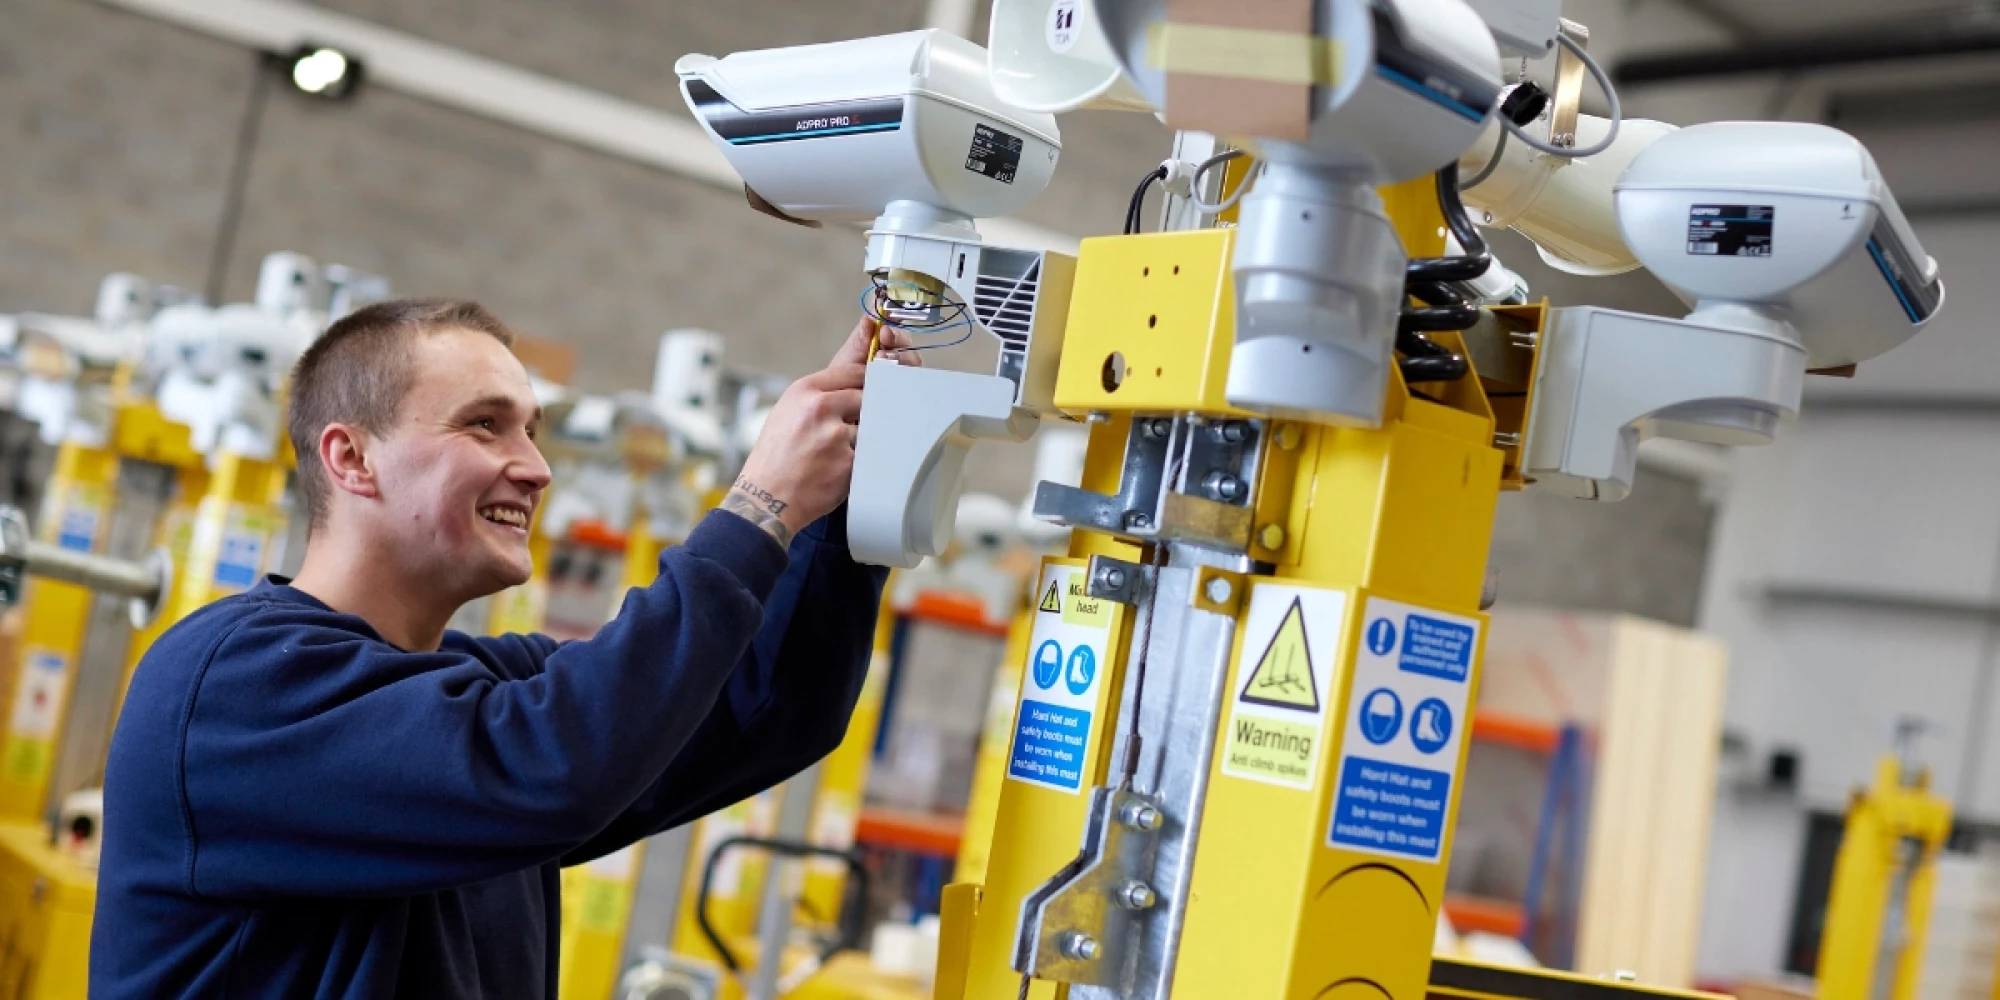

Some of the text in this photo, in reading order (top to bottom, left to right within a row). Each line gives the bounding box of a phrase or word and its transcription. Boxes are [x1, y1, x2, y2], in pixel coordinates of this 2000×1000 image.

[1076, 600, 1099, 614] head
[1421, 622, 1432, 633] be
[1445, 640, 1462, 651] and
[1032, 708, 1078, 728] Hard Hat and
[1022, 726, 1082, 746] safety boots must
[1237, 720, 1311, 760] Warning
[1025, 742, 1072, 762] be worn when
[1231, 753, 1248, 766] Anti
[1013, 757, 1044, 775] installing
[1045, 764, 1059, 777] this
[1361, 767, 1432, 790] Hard Hat and
[1345, 785, 1440, 811] safety boots must
[1352, 804, 1427, 828] be worn when
[1336, 822, 1385, 844] installing
[1386, 829, 1407, 845] this
